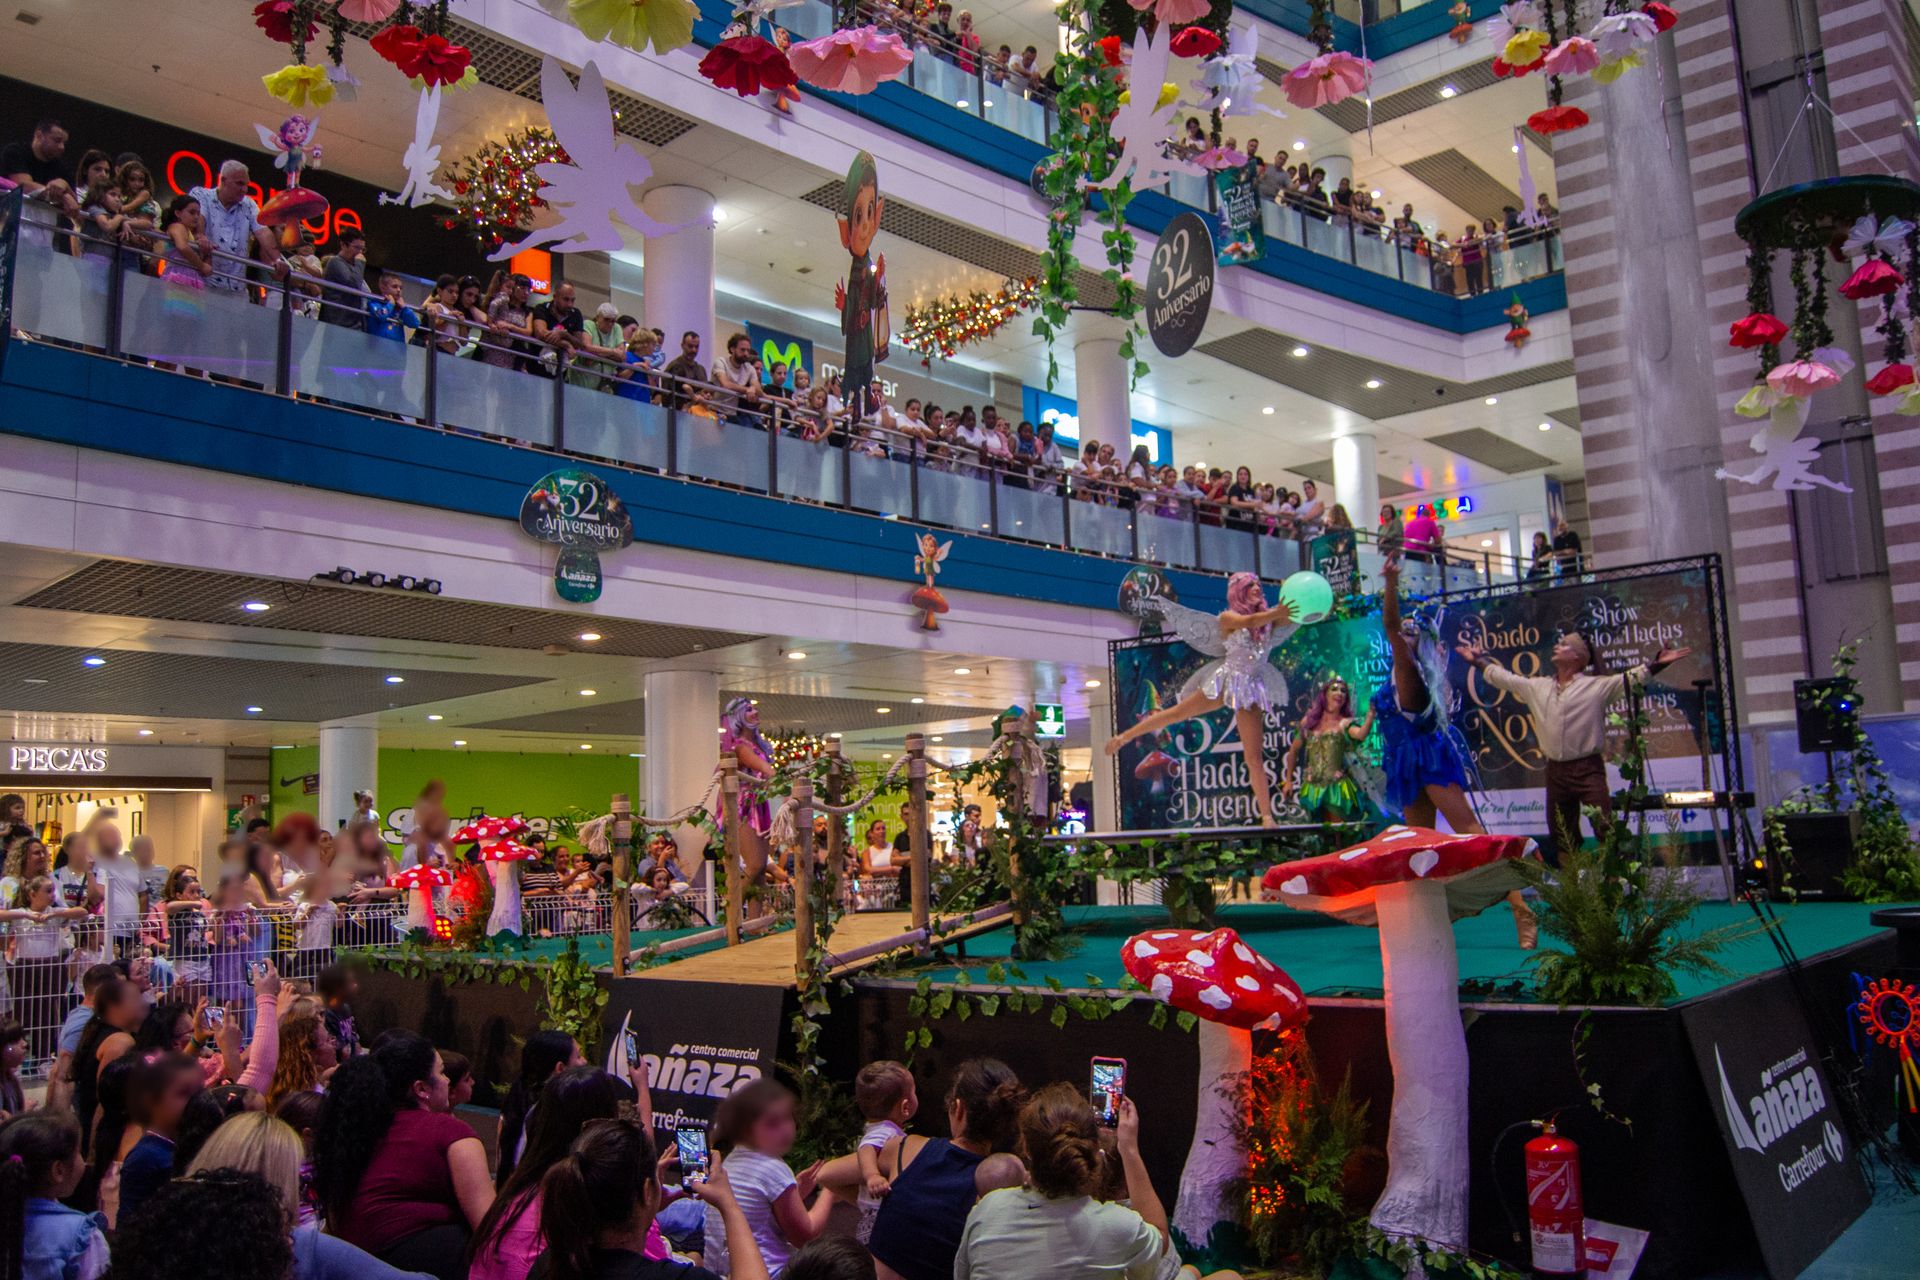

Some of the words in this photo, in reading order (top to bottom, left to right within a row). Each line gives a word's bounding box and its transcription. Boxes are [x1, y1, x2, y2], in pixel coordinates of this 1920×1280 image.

[1156, 228, 1193, 300] 32
[1152, 275, 1211, 330] Aniversario
[559, 477, 600, 520] 32
[536, 513, 620, 545] Aniversario
[1587, 597, 1641, 627] Show
[1622, 620, 1684, 648] Hadas
[10, 746, 109, 772] PECA'S
[690, 1043, 717, 1056] centro
[717, 1047, 760, 1061] comercial
[1778, 1144, 1827, 1193] Carrefour
